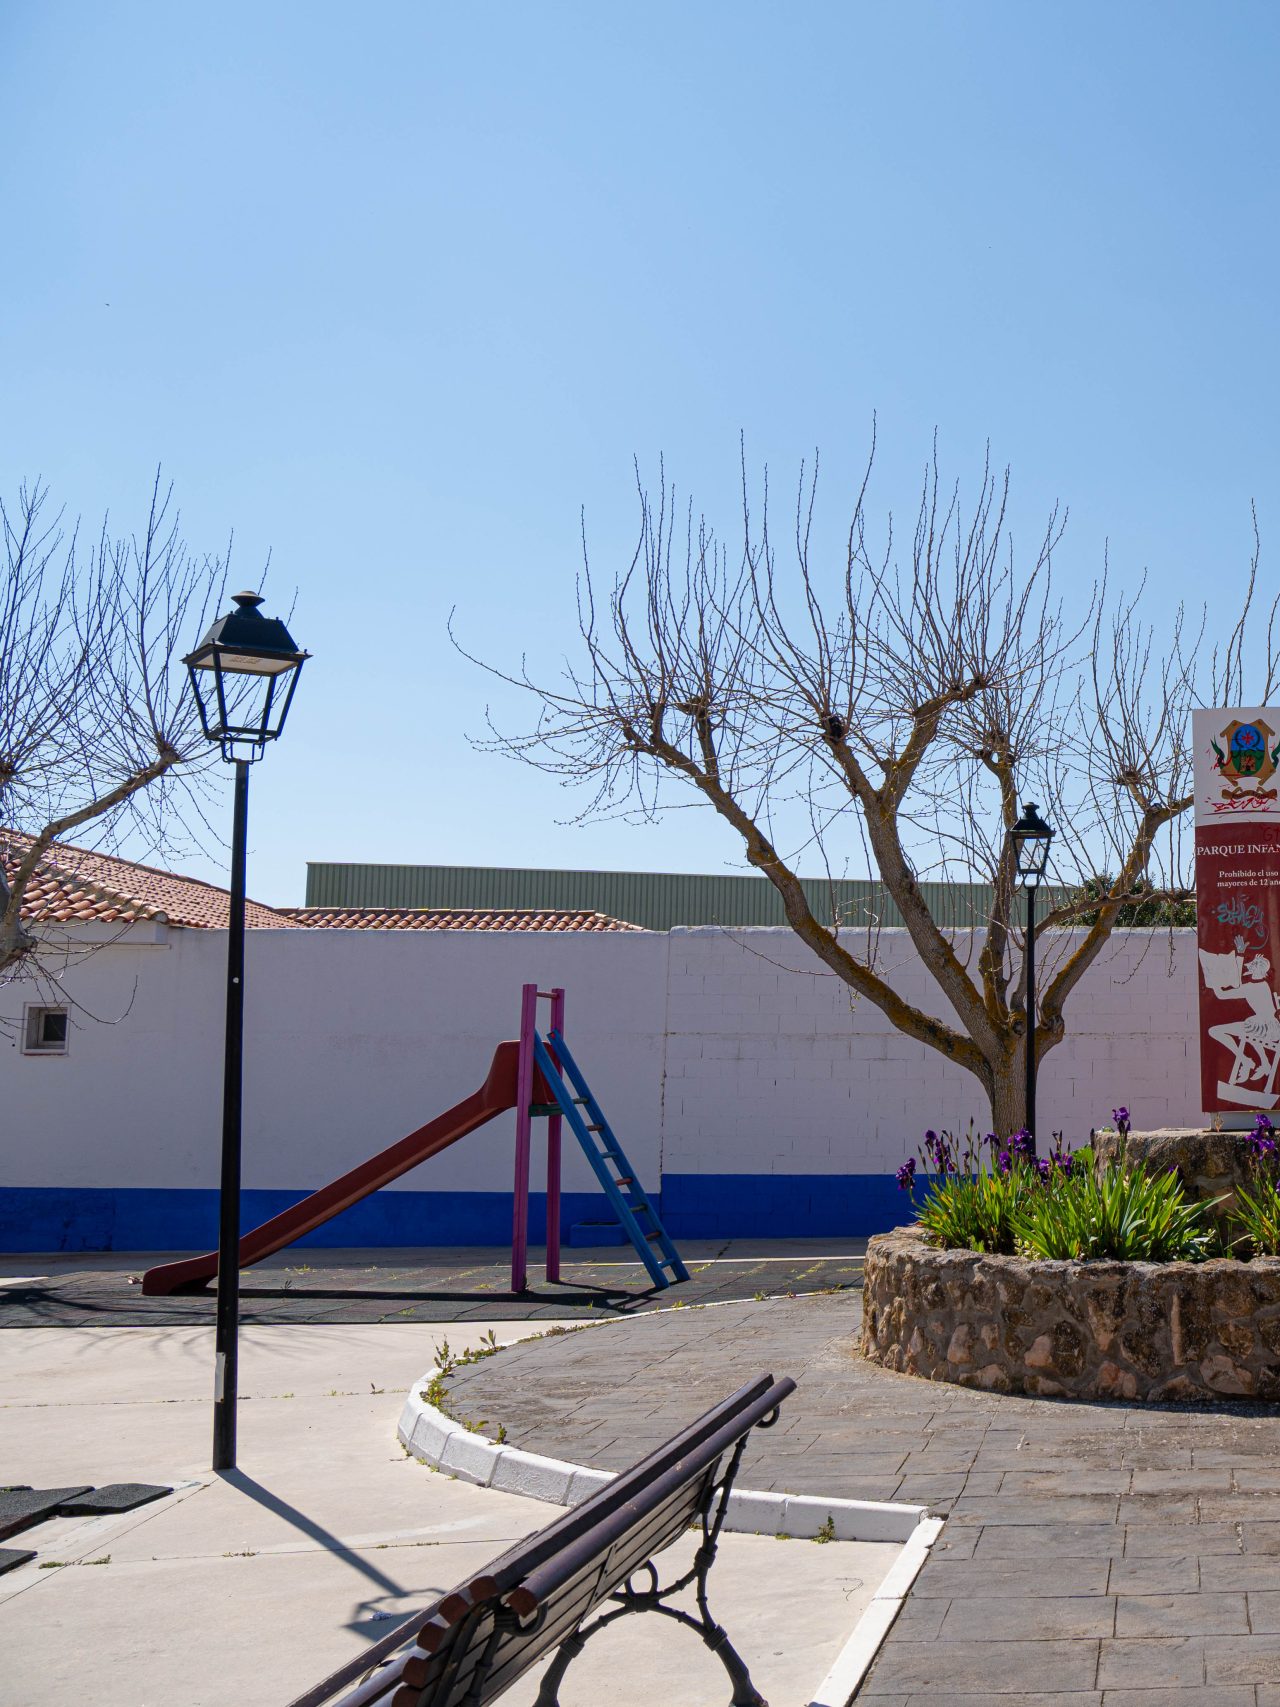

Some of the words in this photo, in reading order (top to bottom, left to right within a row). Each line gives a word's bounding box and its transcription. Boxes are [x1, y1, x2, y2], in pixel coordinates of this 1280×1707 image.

[1196, 844, 1245, 857] PARQUE
[1219, 870, 1256, 878] Prohibido
[1257, 869, 1264, 877] el
[1217, 880, 1248, 888] mayores
[1249, 878, 1258, 886] de
[1260, 878, 1268, 886] 12
